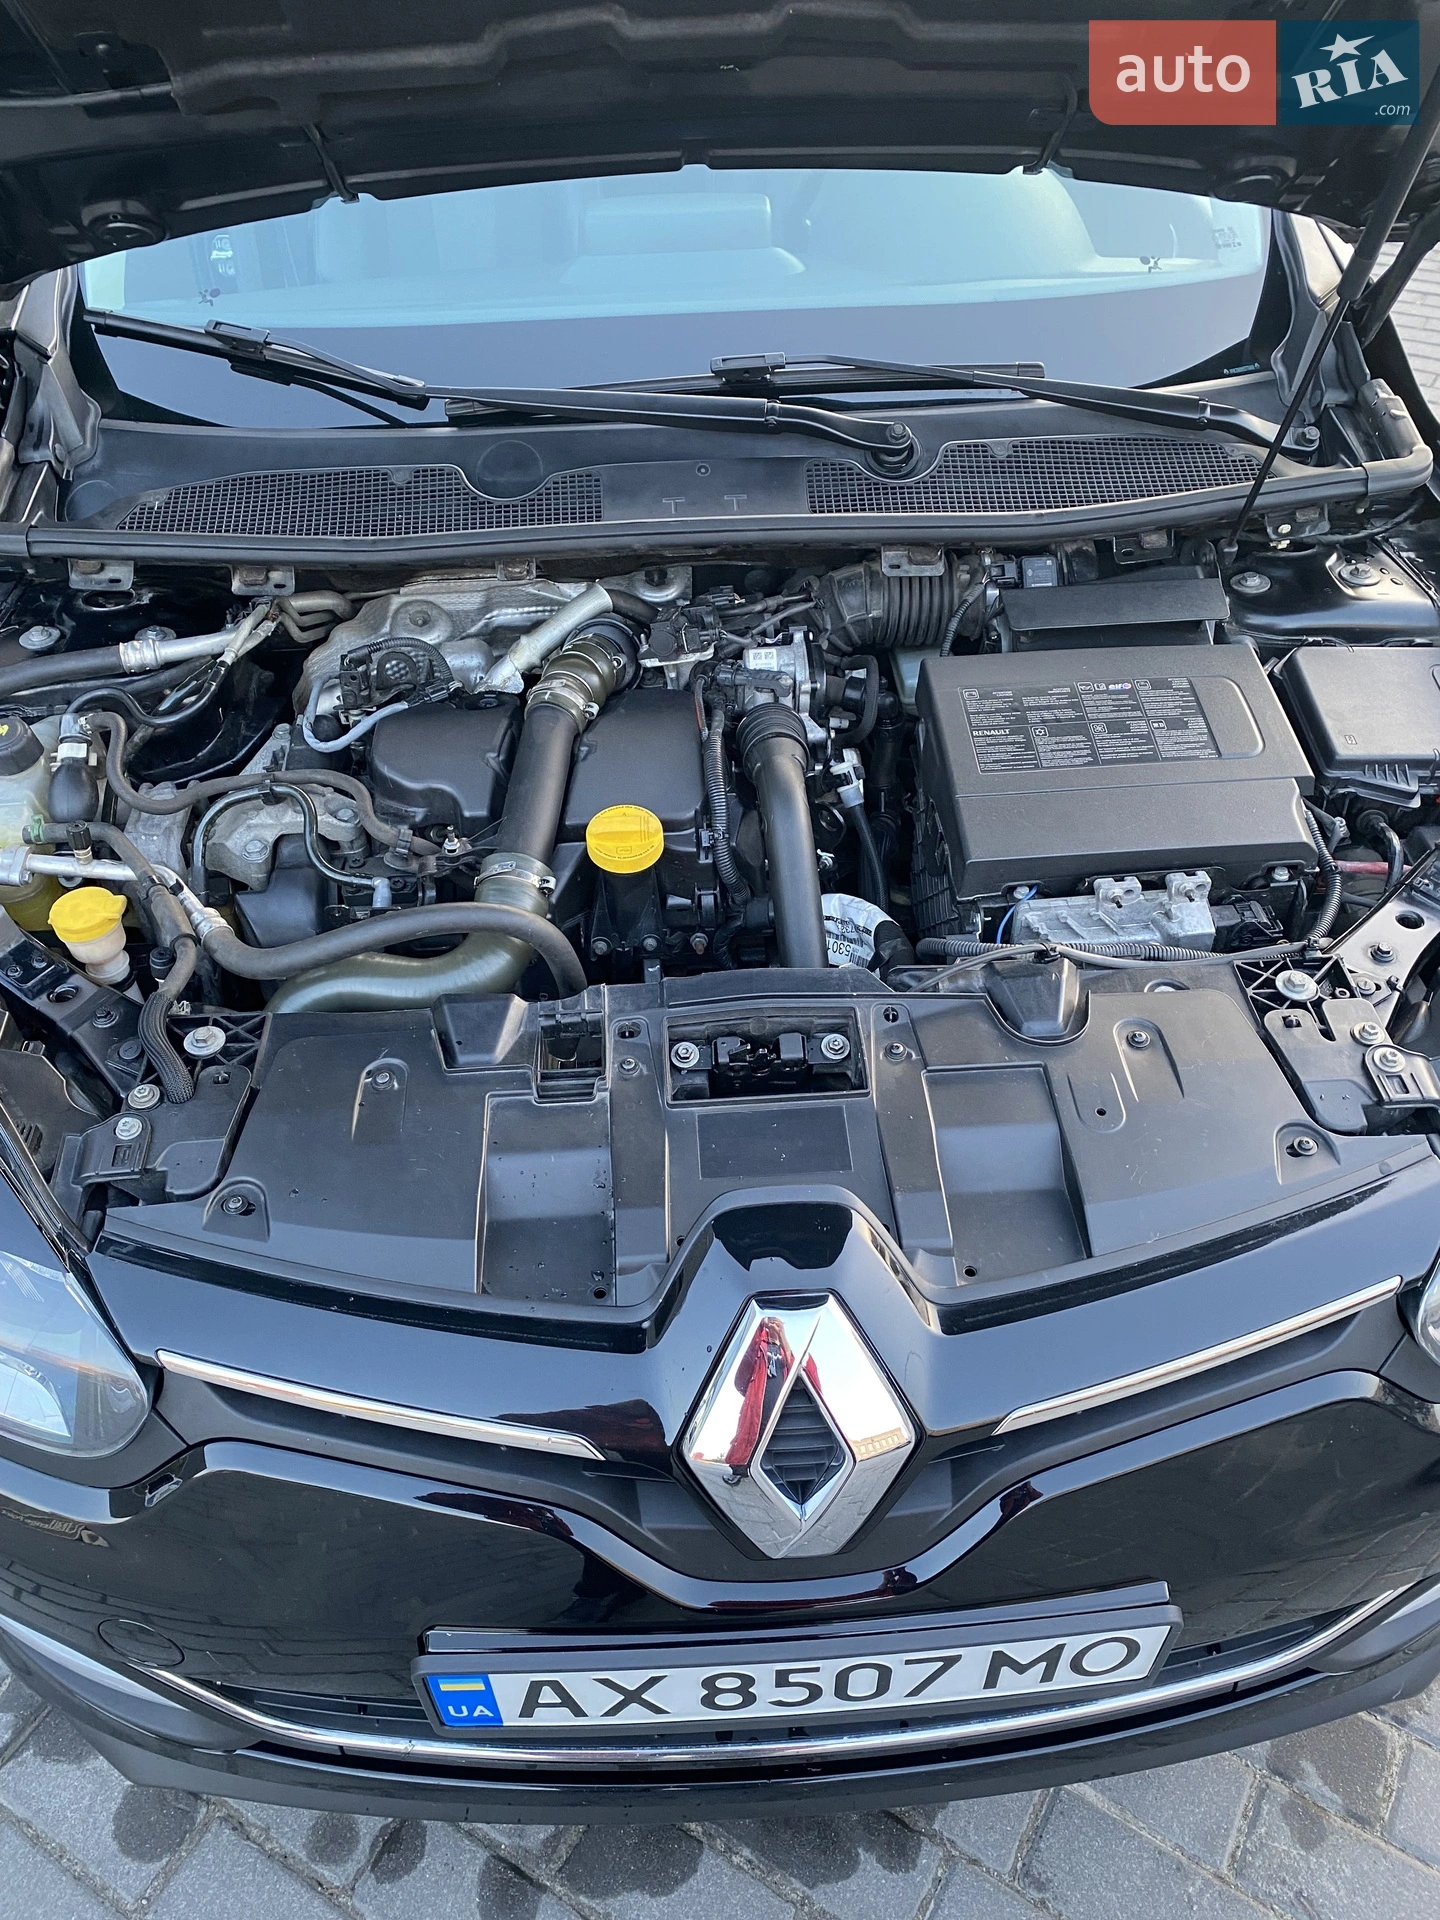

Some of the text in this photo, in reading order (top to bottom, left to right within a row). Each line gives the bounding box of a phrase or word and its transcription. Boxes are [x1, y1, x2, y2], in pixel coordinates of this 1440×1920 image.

[972, 729, 1011, 737] RENAULT
[518, 1636, 1142, 1719] AX 8507 MO
[447, 1704, 494, 1718] UA
